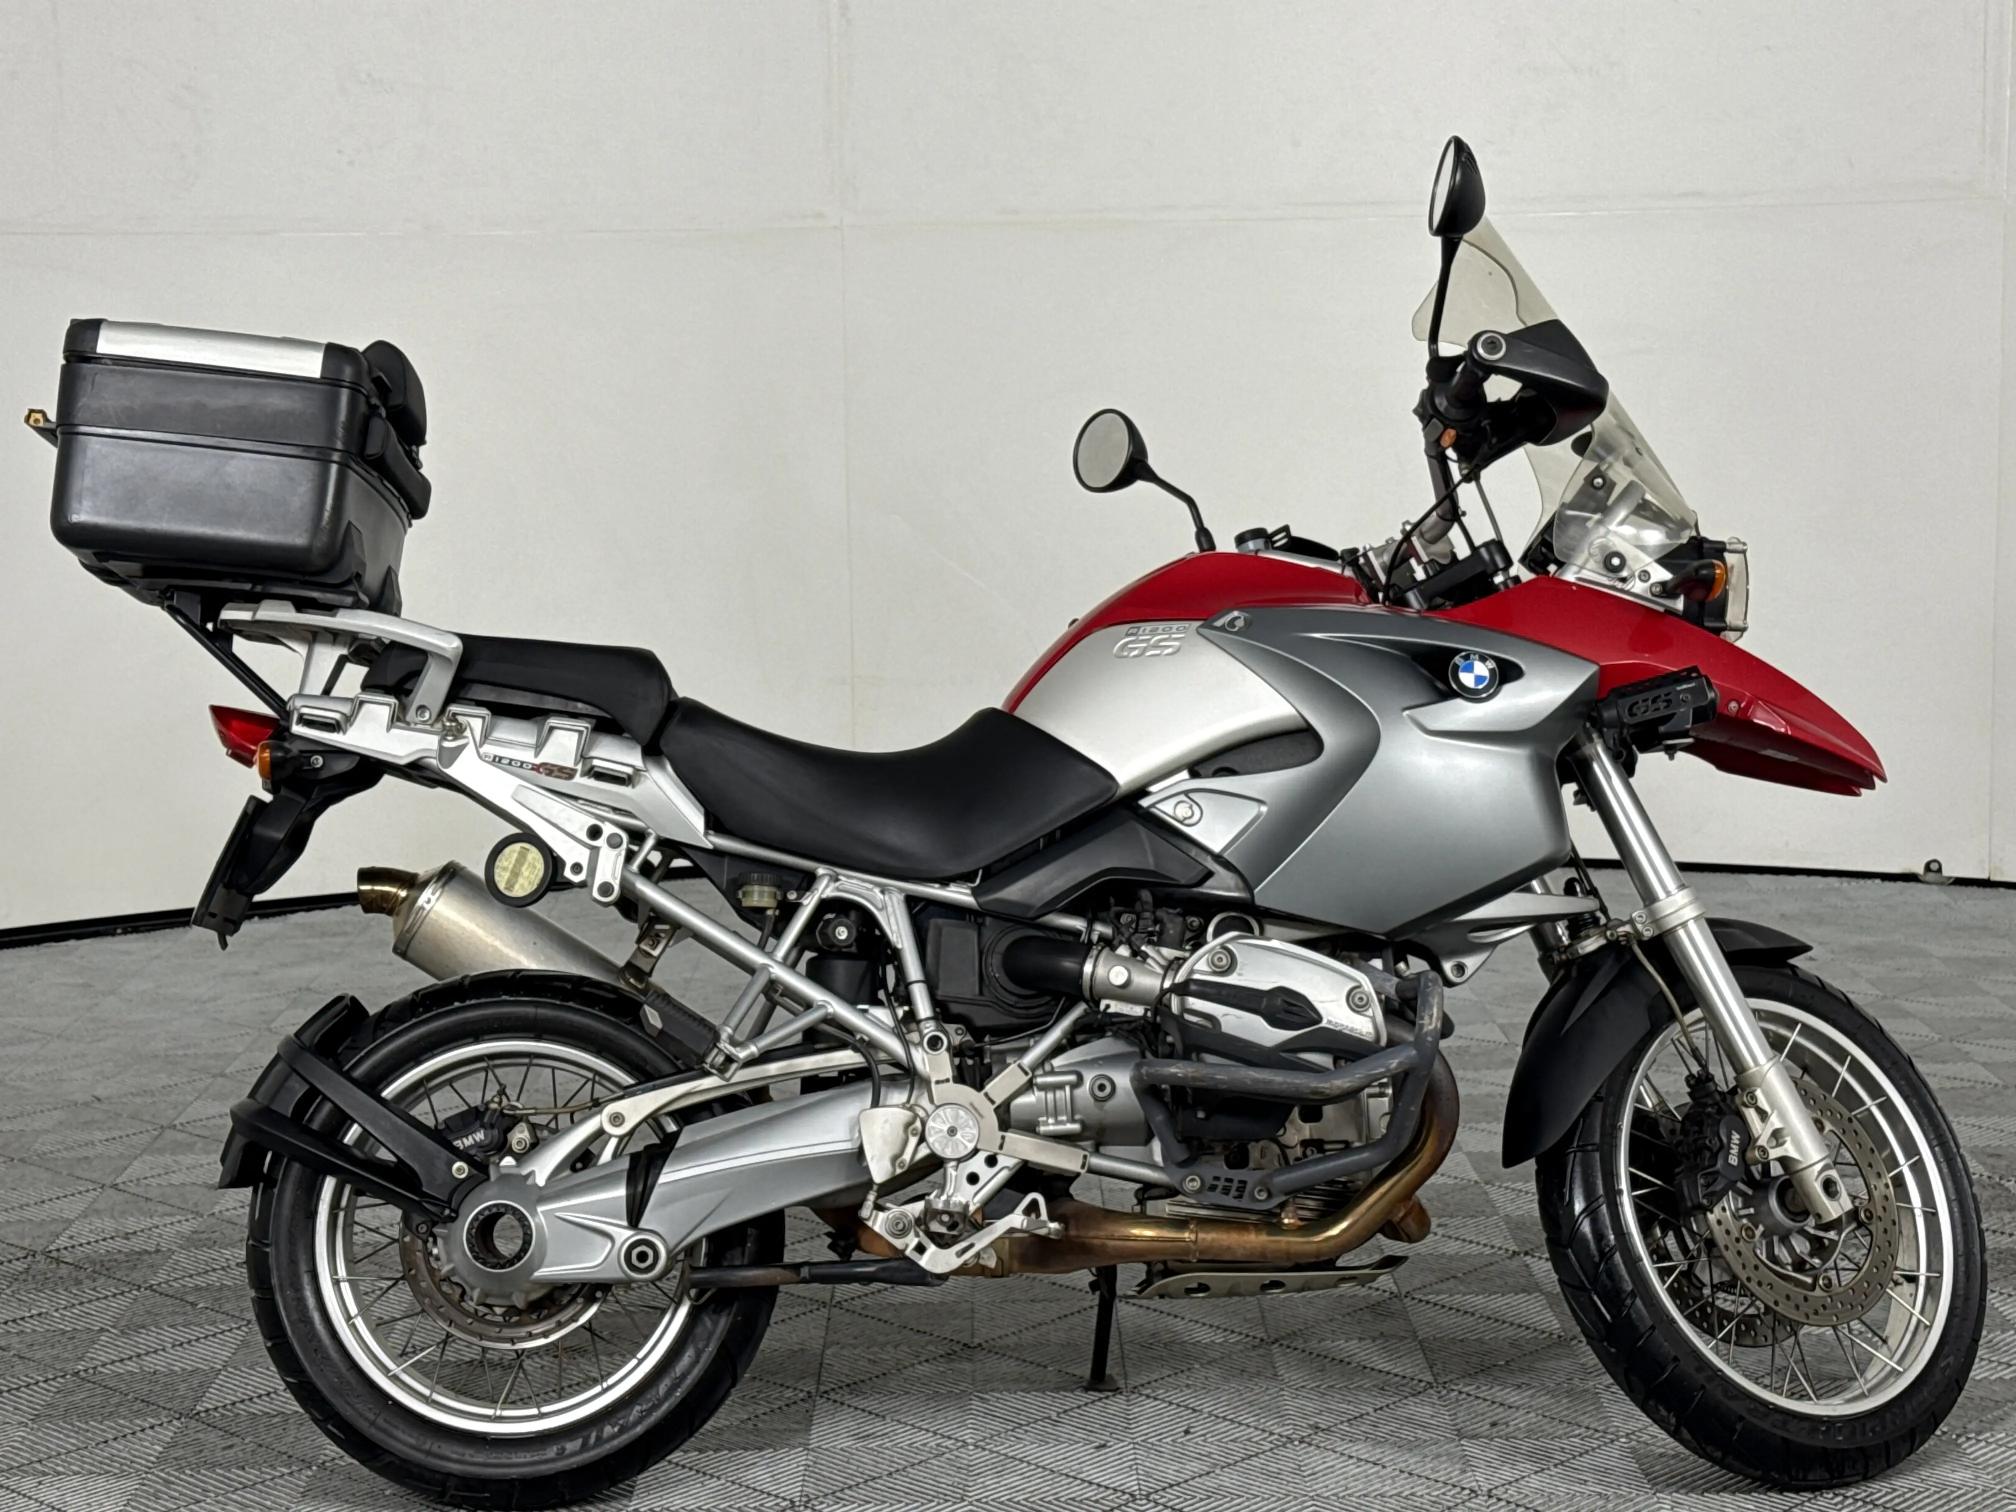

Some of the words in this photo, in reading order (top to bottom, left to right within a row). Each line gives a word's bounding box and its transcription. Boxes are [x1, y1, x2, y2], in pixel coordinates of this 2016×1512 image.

[1113, 633, 1186, 659] GS
[1455, 653, 1496, 669] BMW
[1626, 692, 1673, 718] GS
[1728, 1129, 1741, 1167] BMW
